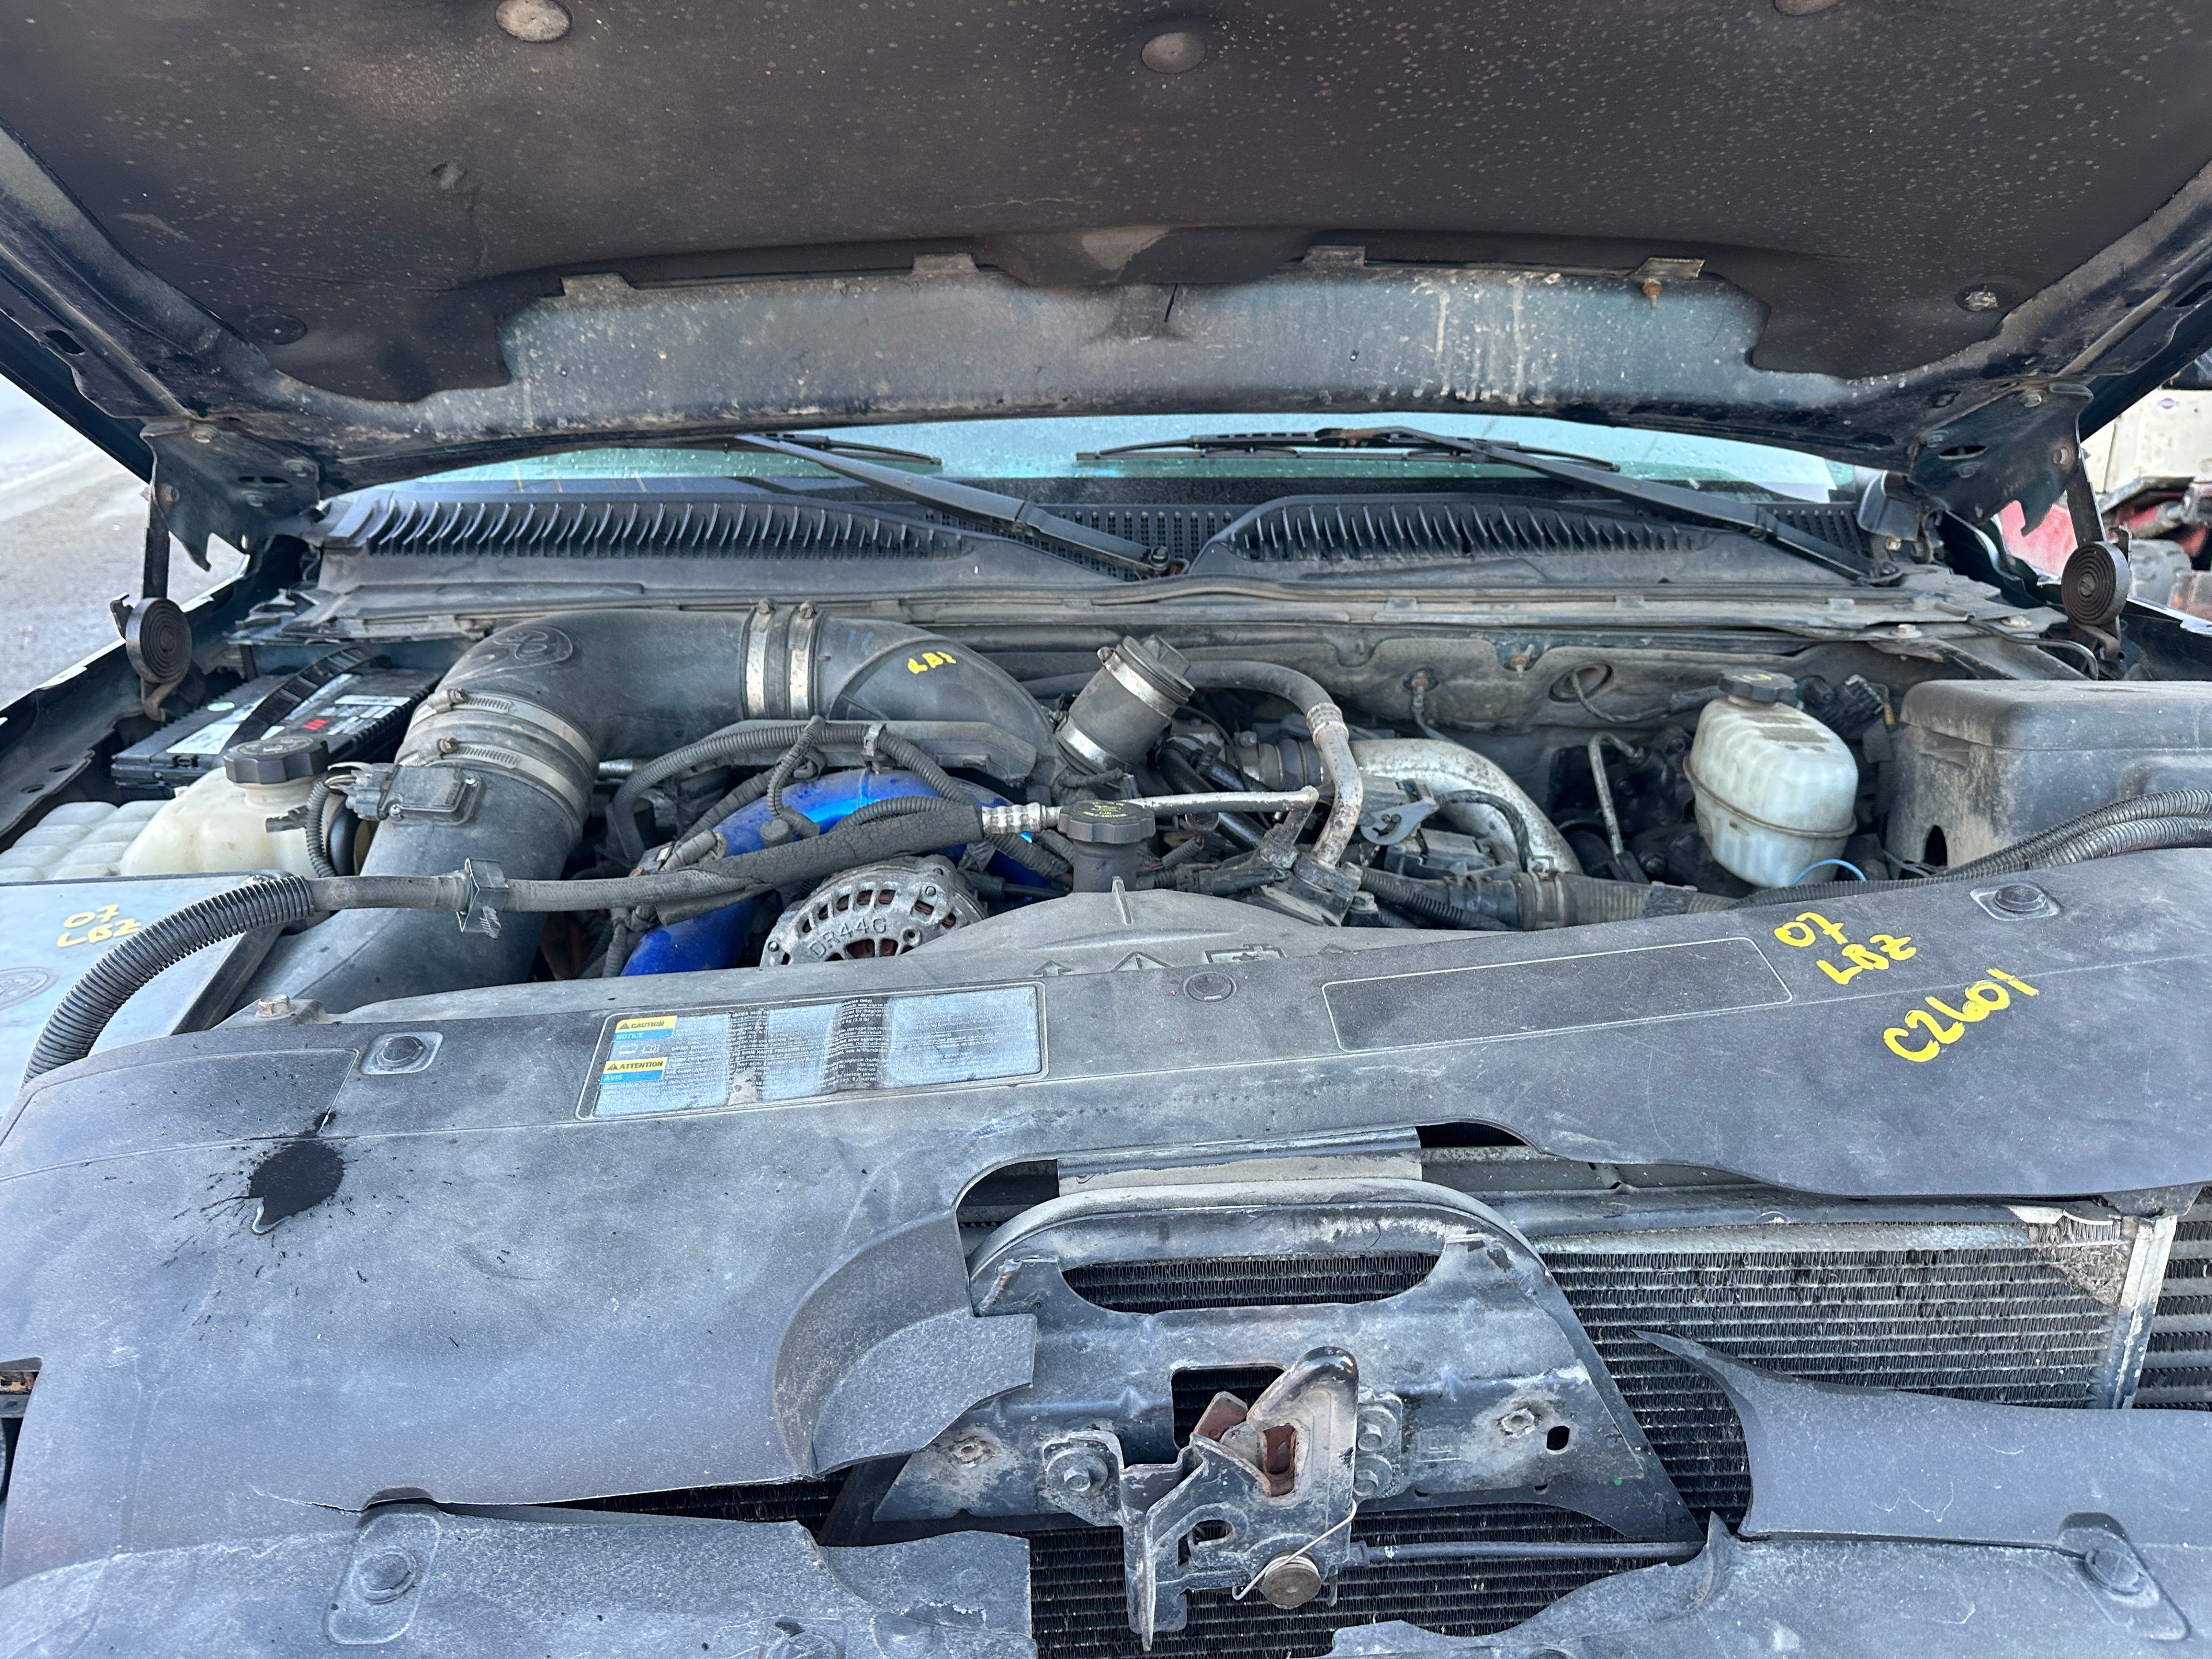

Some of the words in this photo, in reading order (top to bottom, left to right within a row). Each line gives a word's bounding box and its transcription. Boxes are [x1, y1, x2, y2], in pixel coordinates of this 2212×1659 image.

[63, 904, 119, 928] 07
[1774, 912, 1848, 947] 07
[1884, 968, 2040, 1063] C2601
[631, 1020, 665, 1029] CAUTION
[615, 1032, 644, 1040] NOTICE
[619, 1061, 663, 1070] ATTENTION
